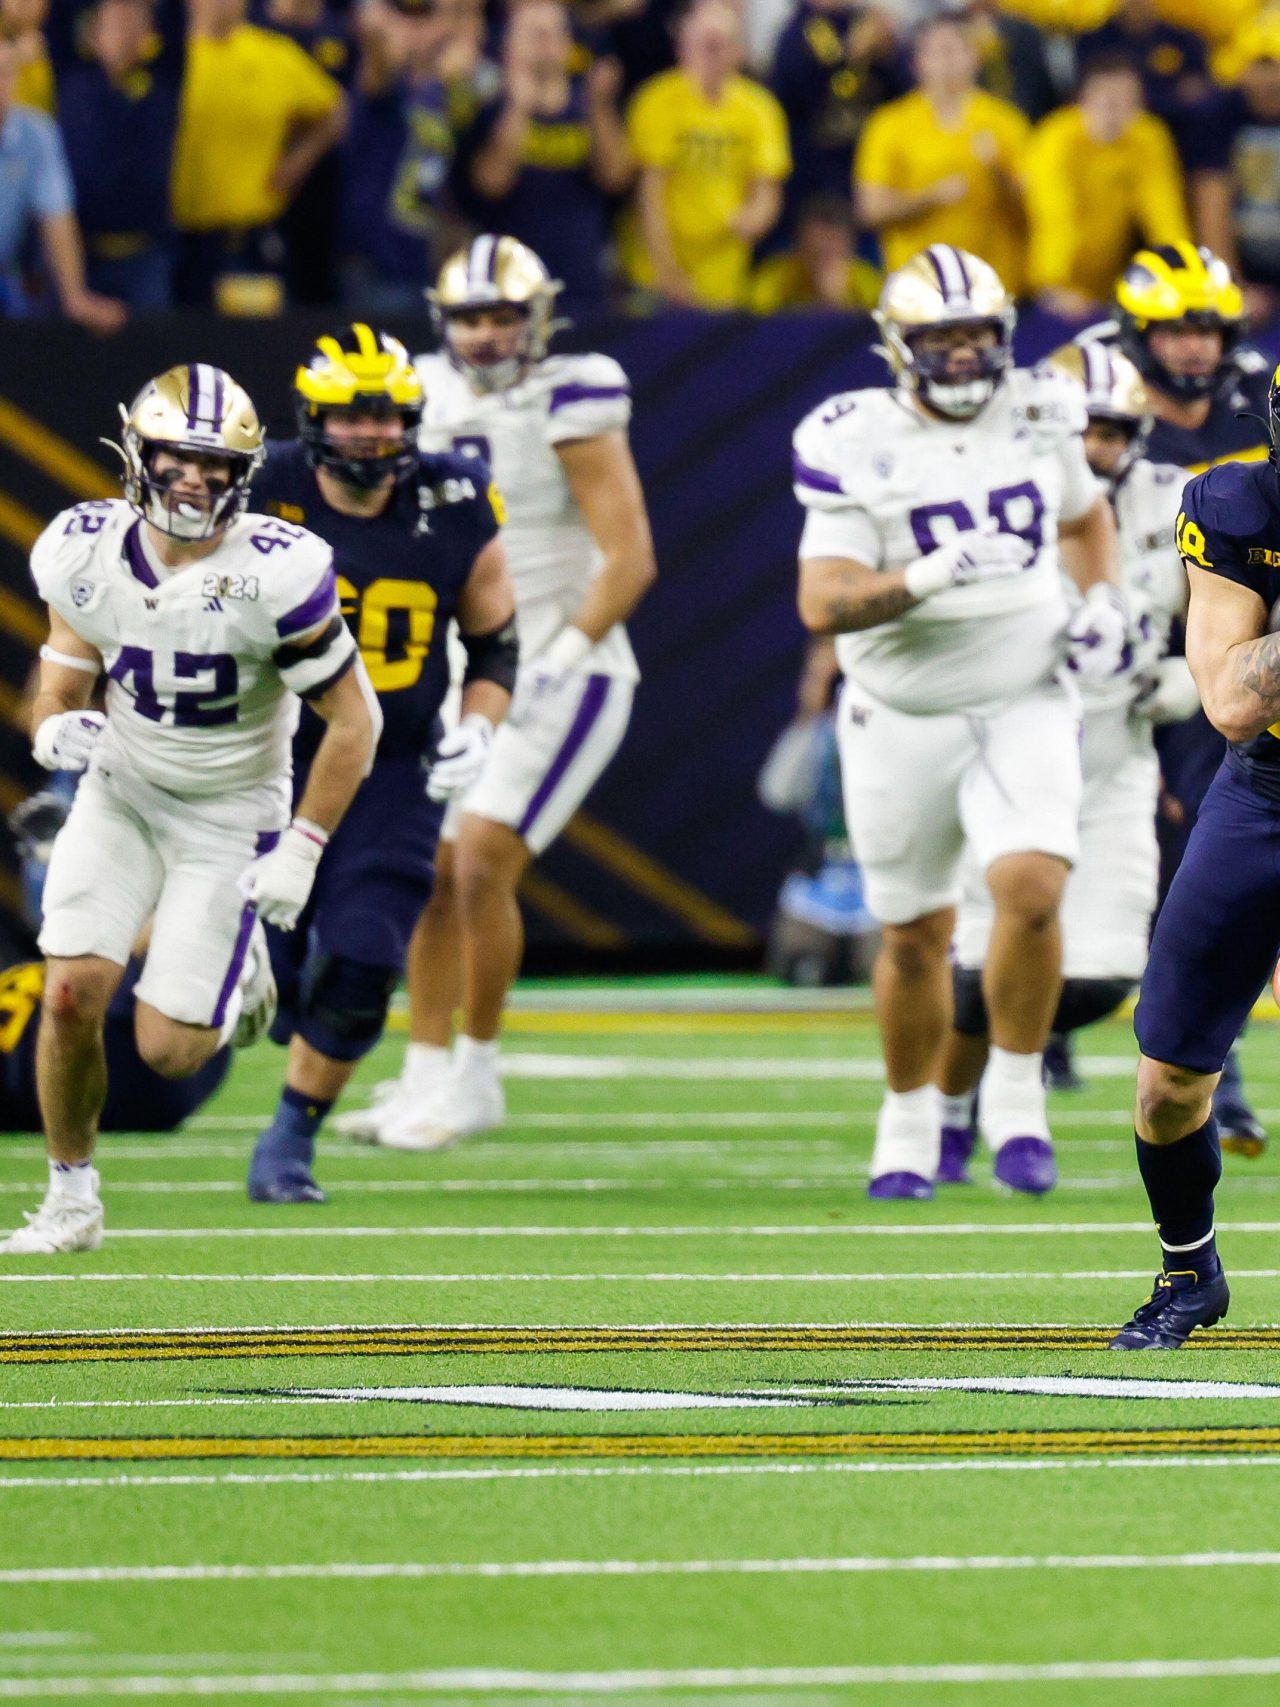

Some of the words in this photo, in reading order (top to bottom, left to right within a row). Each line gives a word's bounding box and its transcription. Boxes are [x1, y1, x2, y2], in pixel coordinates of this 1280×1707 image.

[202, 573, 259, 600] 2024
[336, 574, 438, 692] 0
[107, 646, 240, 728] 42
